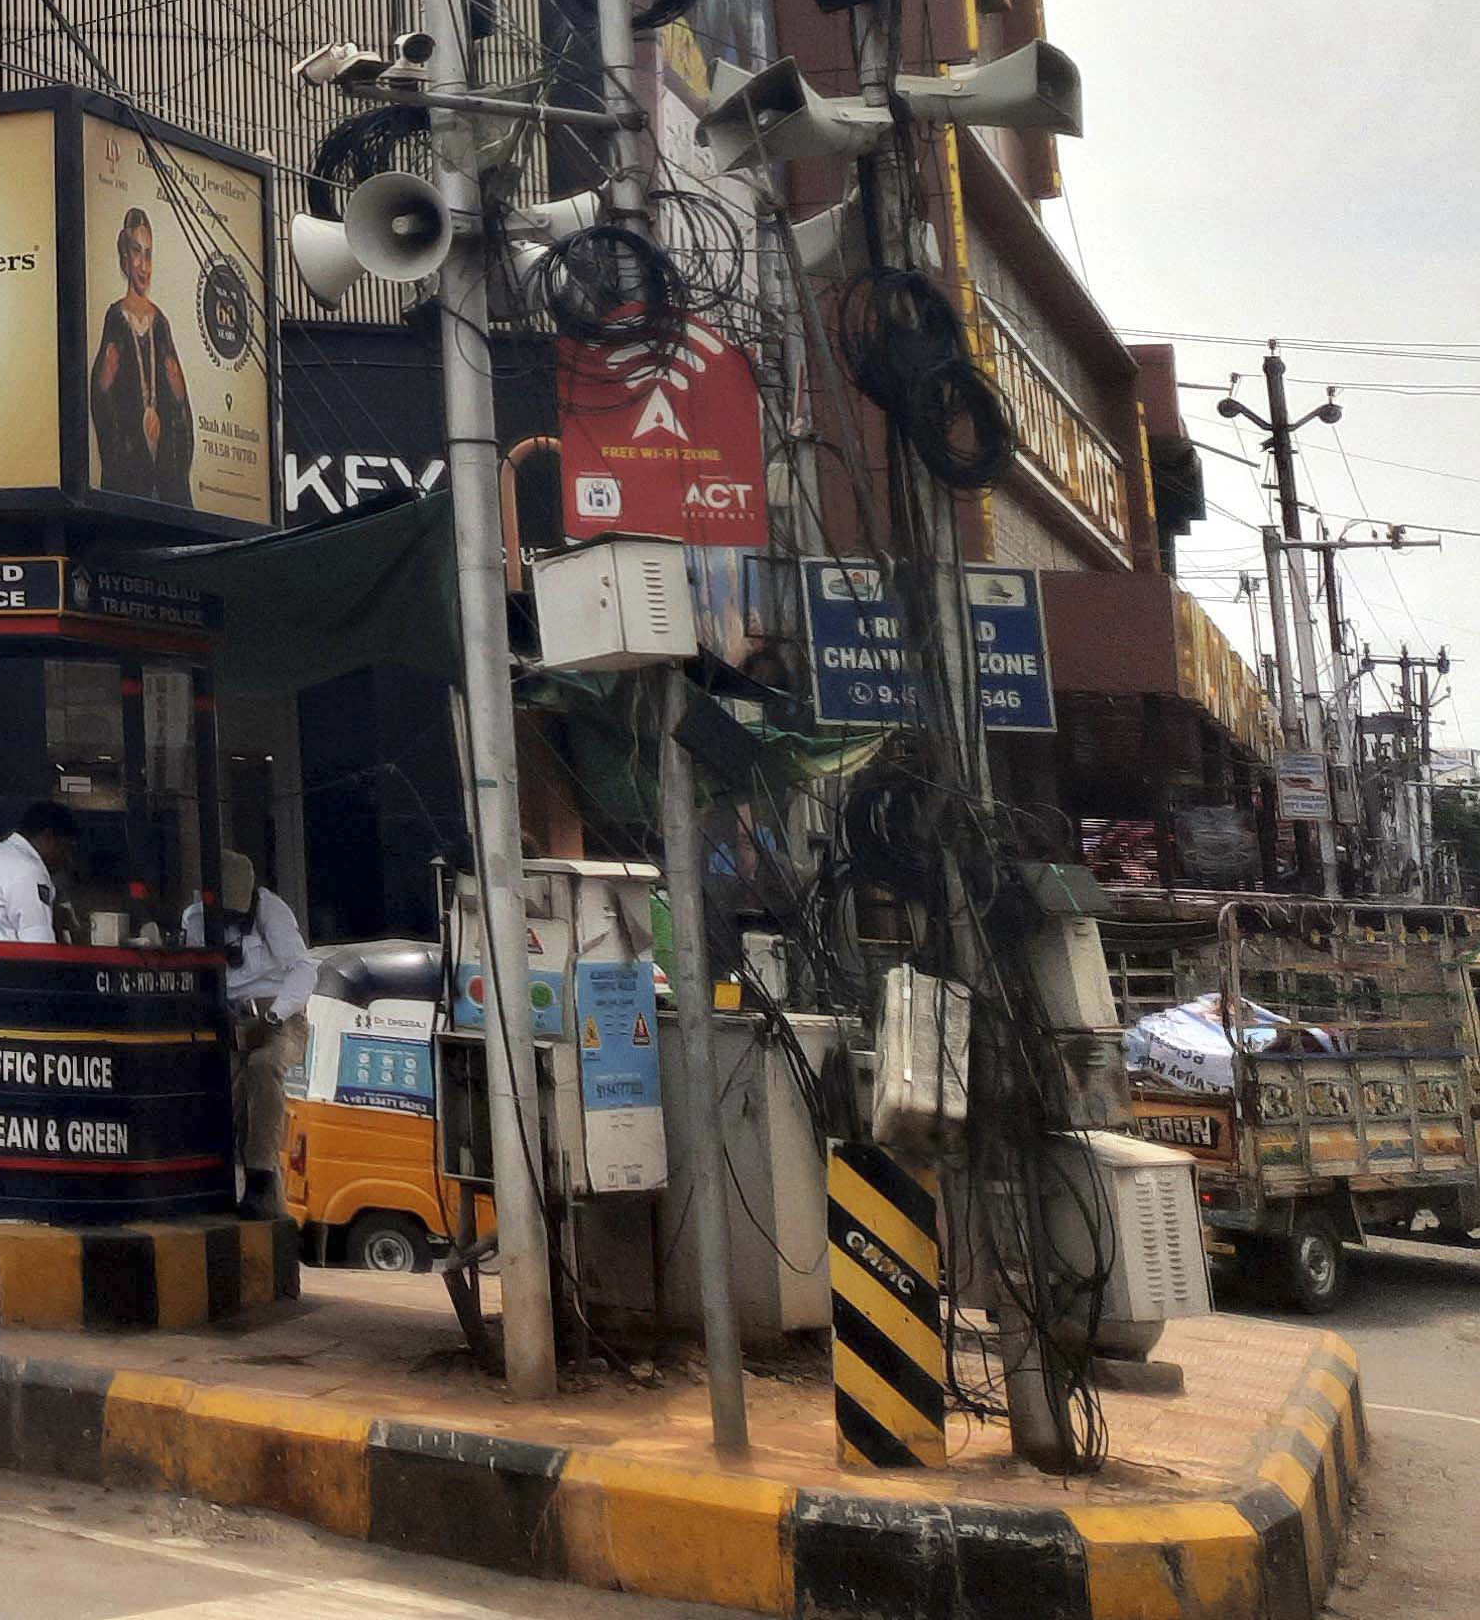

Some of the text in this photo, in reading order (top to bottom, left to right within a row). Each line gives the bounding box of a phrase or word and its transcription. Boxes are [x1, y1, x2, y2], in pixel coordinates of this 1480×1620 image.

[600, 446, 721, 461] FREE WI-FI ZONE
[684, 482, 753, 509] ACT
[45, 1122, 61, 1152] &
[67, 1121, 129, 1155] GREEN
